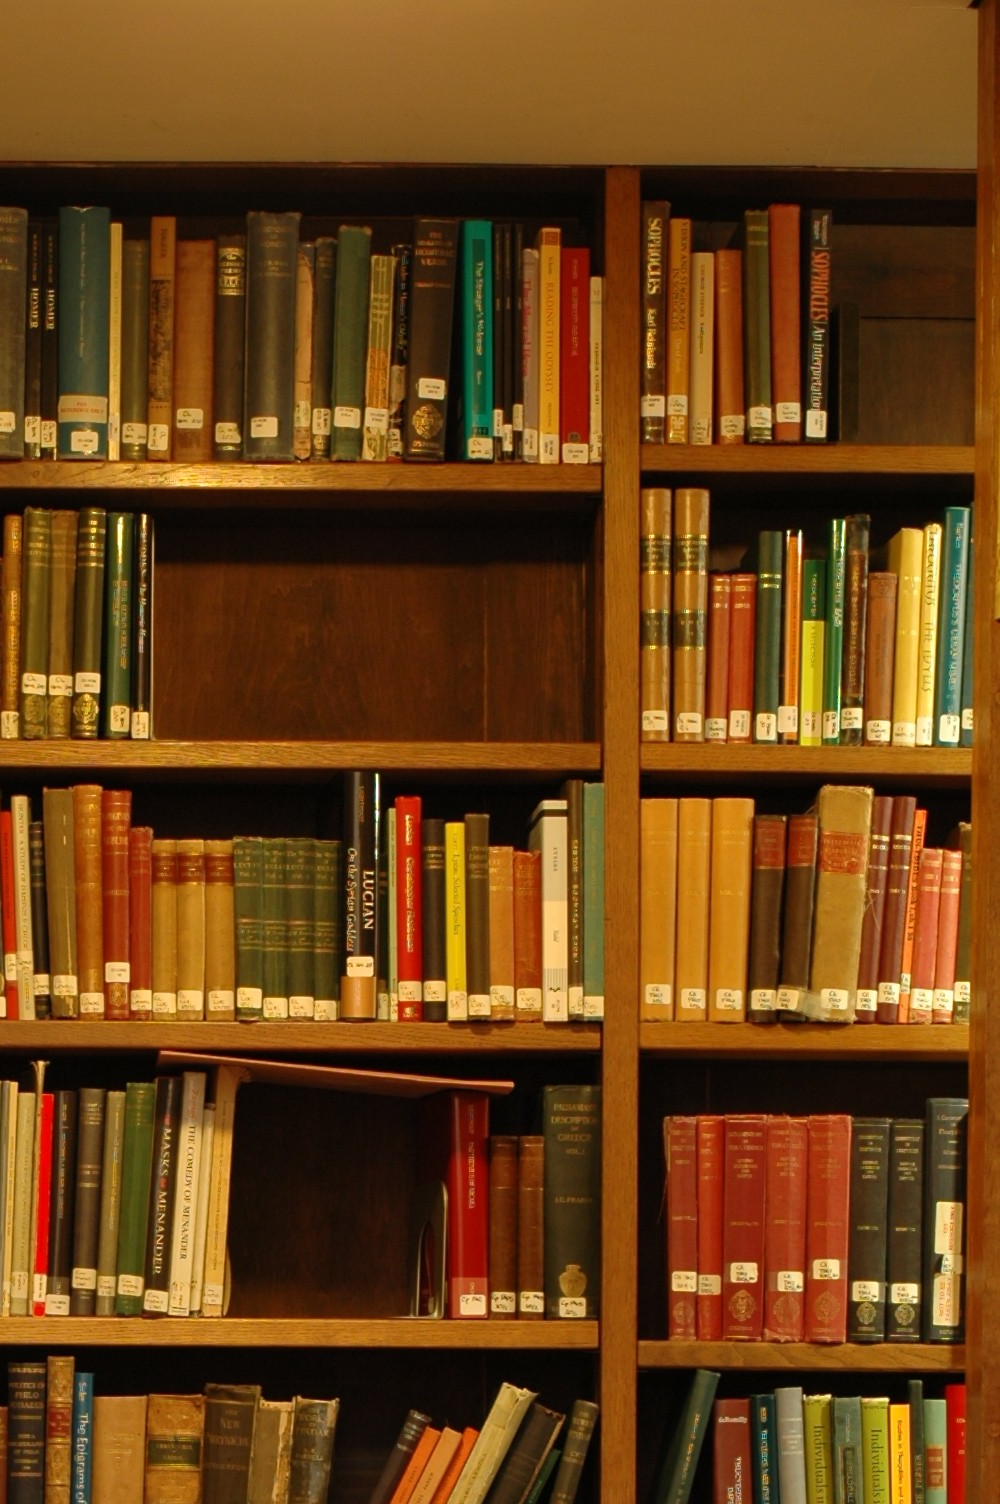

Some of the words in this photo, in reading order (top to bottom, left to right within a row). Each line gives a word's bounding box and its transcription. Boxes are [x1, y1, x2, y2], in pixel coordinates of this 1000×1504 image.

[475, 261, 484, 280] The
[646, 217, 662, 295] SOPHOCLES
[544, 282, 554, 328] READING
[810, 251, 831, 321] SOPHOCLES
[30, 287, 39, 330] HOMER
[46, 289, 55, 330] HOMER
[404, 814, 414, 846] Lucian
[346, 847, 357, 862] On
[347, 864, 357, 880] the
[345, 881, 357, 912] Syrian
[362, 870, 375, 930] LUCIAN
[345, 913, 357, 952] Goddess
[158, 1127, 172, 1177] MASKS
[186, 1125, 197, 1143] THE
[182, 1146, 194, 1189] COMEDY
[182, 1189, 191, 1205] OF
[152, 1190, 166, 1275] MENANDER
[178, 1206, 190, 1261] MENANDER
[77, 1413, 89, 1435] The
[72, 1436, 88, 1490] Epigrams
[812, 1424, 826, 1494] Individuals
[870, 1428, 883, 1498] Individuals
[75, 1491, 88, 1504] of
